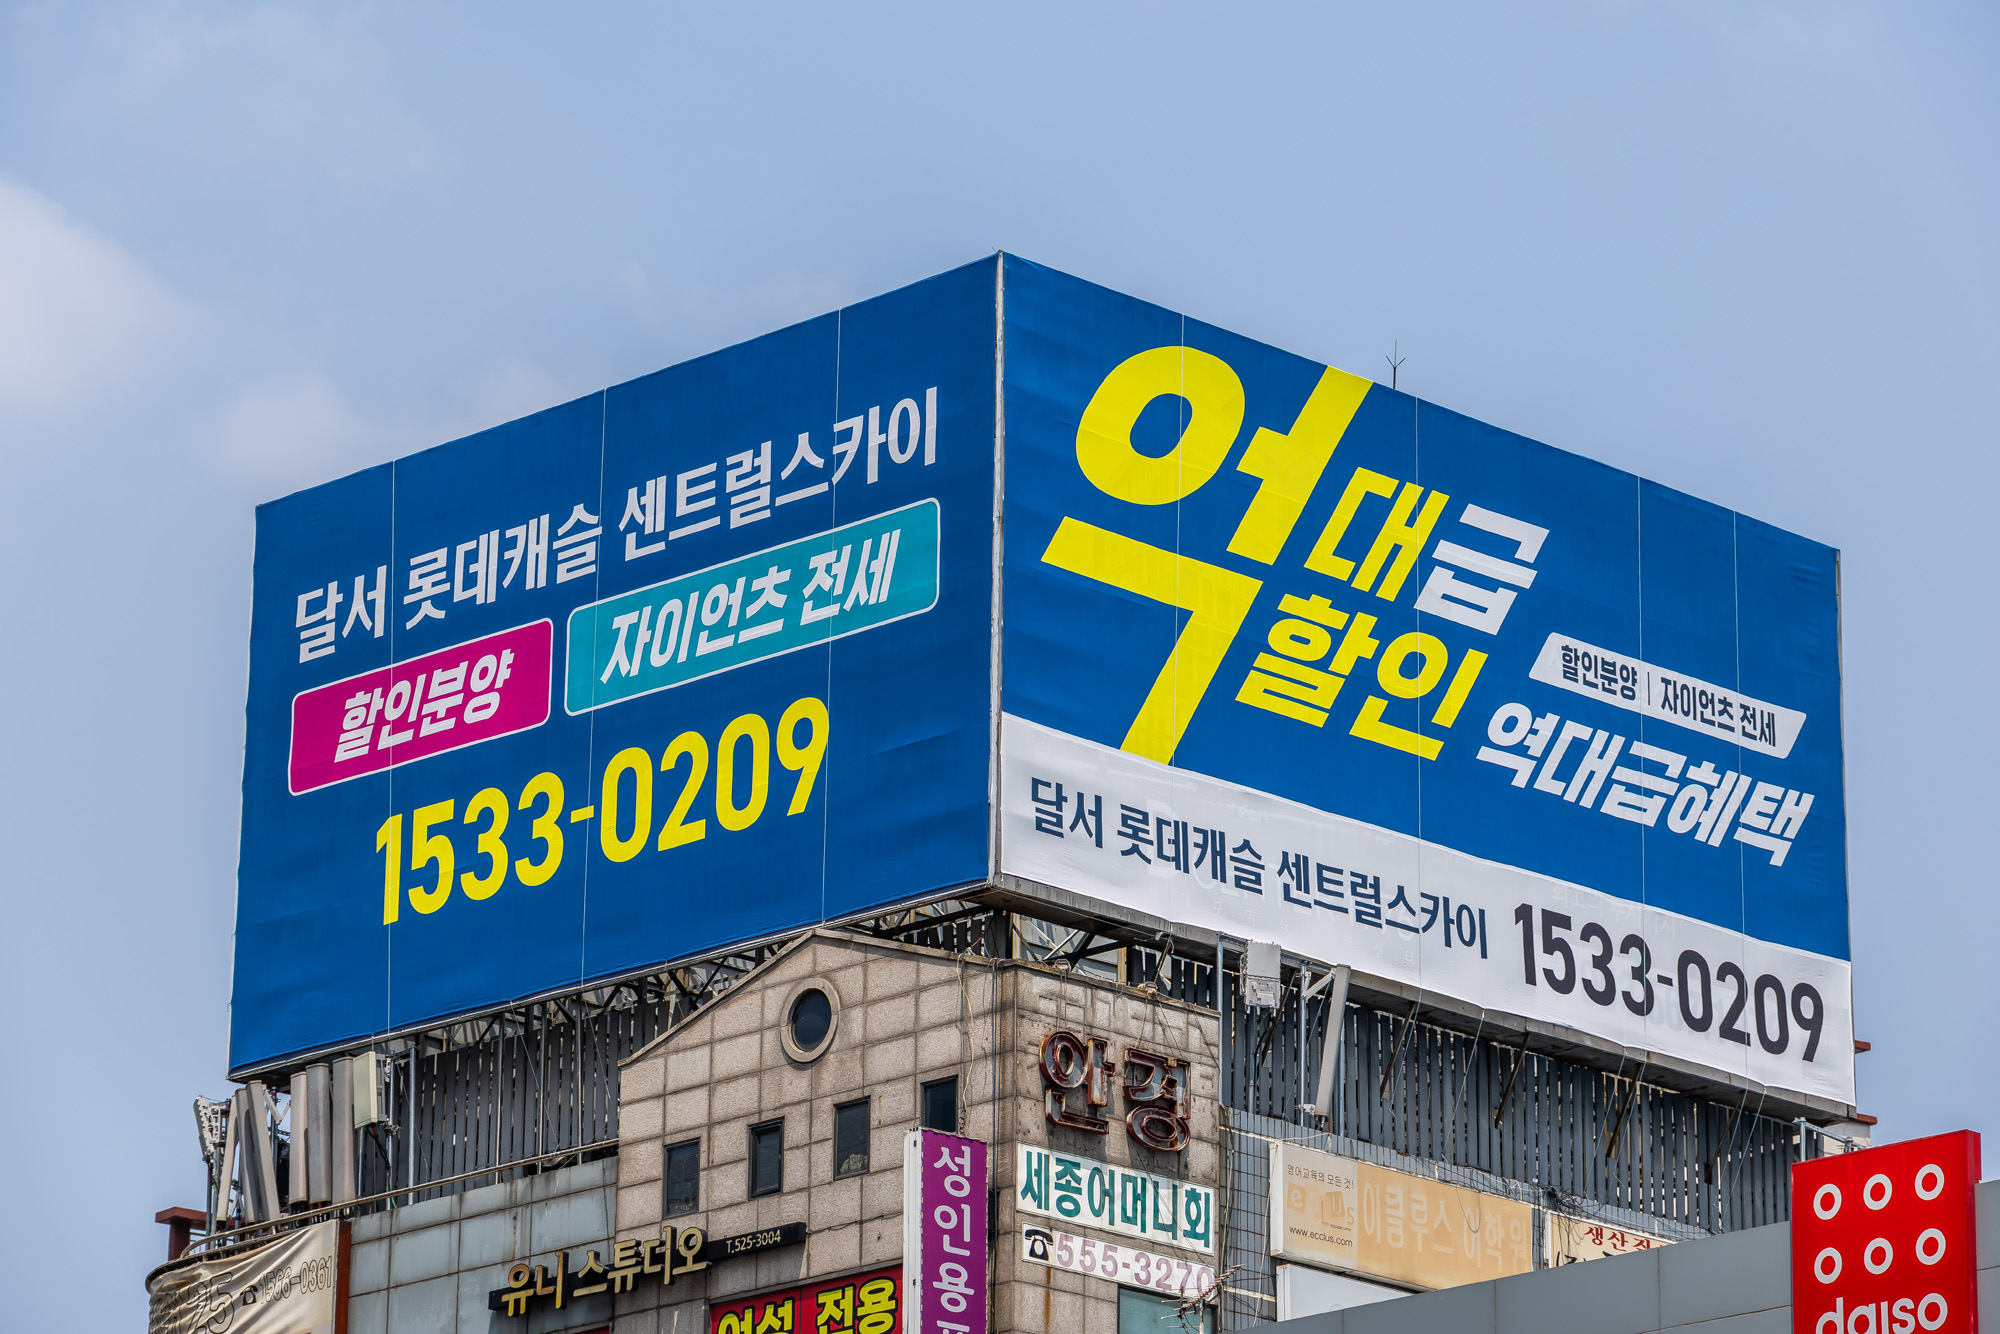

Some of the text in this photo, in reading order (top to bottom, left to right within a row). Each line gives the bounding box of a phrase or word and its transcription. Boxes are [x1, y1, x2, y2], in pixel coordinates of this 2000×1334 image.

[295, 386, 937, 664] 달서 롯데캐슬 센트럴스카이
[600, 529, 901, 684] 자이언츠 전세
[334, 648, 515, 763] 할인분양
[1235, 593, 1489, 761] 할인
[1561, 644, 1776, 747] 할인분양 자이언츠 전세
[375, 697, 830, 926] 1533-0209
[1475, 702, 1815, 868] 역대급혜택
[1031, 776, 1488, 960] 달서 롯데캐슬 센트럴스카이
[1514, 903, 1824, 1063] 1533-0209
[1038, 1031, 1192, 1152] 안경
[1020, 1150, 1211, 1249] 세종어머니회
[1287, 1164, 1354, 1190] 영어교육의 모든 것!
[1363, 1182, 1528, 1274] 이클루스 어학원
[258, 1255, 333, 1305] 1566-0361
[501, 1225, 709, 1317] 유니 스튜디오
[725, 1229, 781, 1254] T.525-3004
[932, 1145, 975, 1334] 성인용
[1056, 1233, 1214, 1301] 555-3270
[717, 1278, 897, 1334] 여성 전용
[1815, 1292, 1948, 1334] daiso
